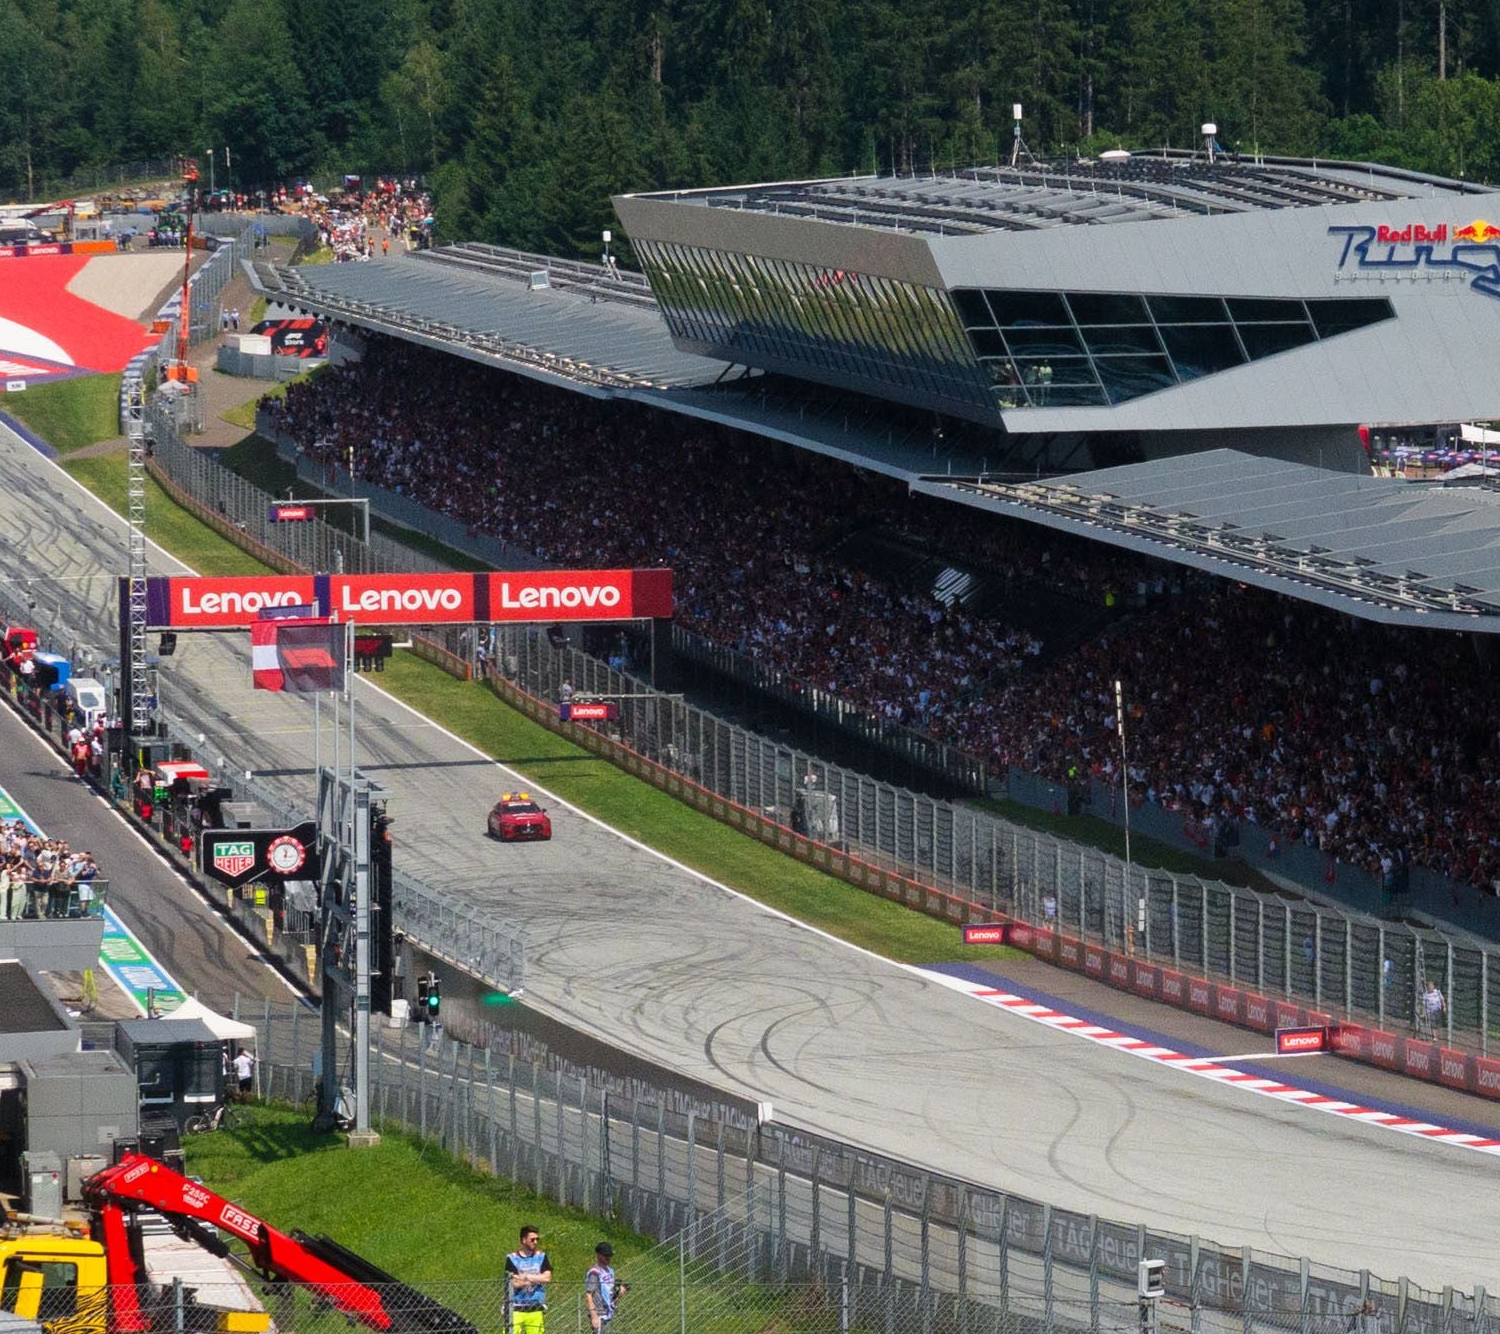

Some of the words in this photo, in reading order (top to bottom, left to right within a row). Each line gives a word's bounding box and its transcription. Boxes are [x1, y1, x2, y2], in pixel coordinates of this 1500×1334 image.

[1377, 223, 1412, 244] Red
[1413, 224, 1448, 244] Bull
[182, 587, 302, 614] Lenovo
[342, 585, 462, 611] Lenovo
[501, 581, 621, 608] Lenovo
[573, 707, 604, 715] Lenovo
[218, 845, 250, 855] TAG
[216, 857, 253, 874] HEUER
[969, 929, 999, 940] Lenovo
[1283, 1036, 1319, 1047] Lenovo
[224, 1206, 261, 1238] FASS
